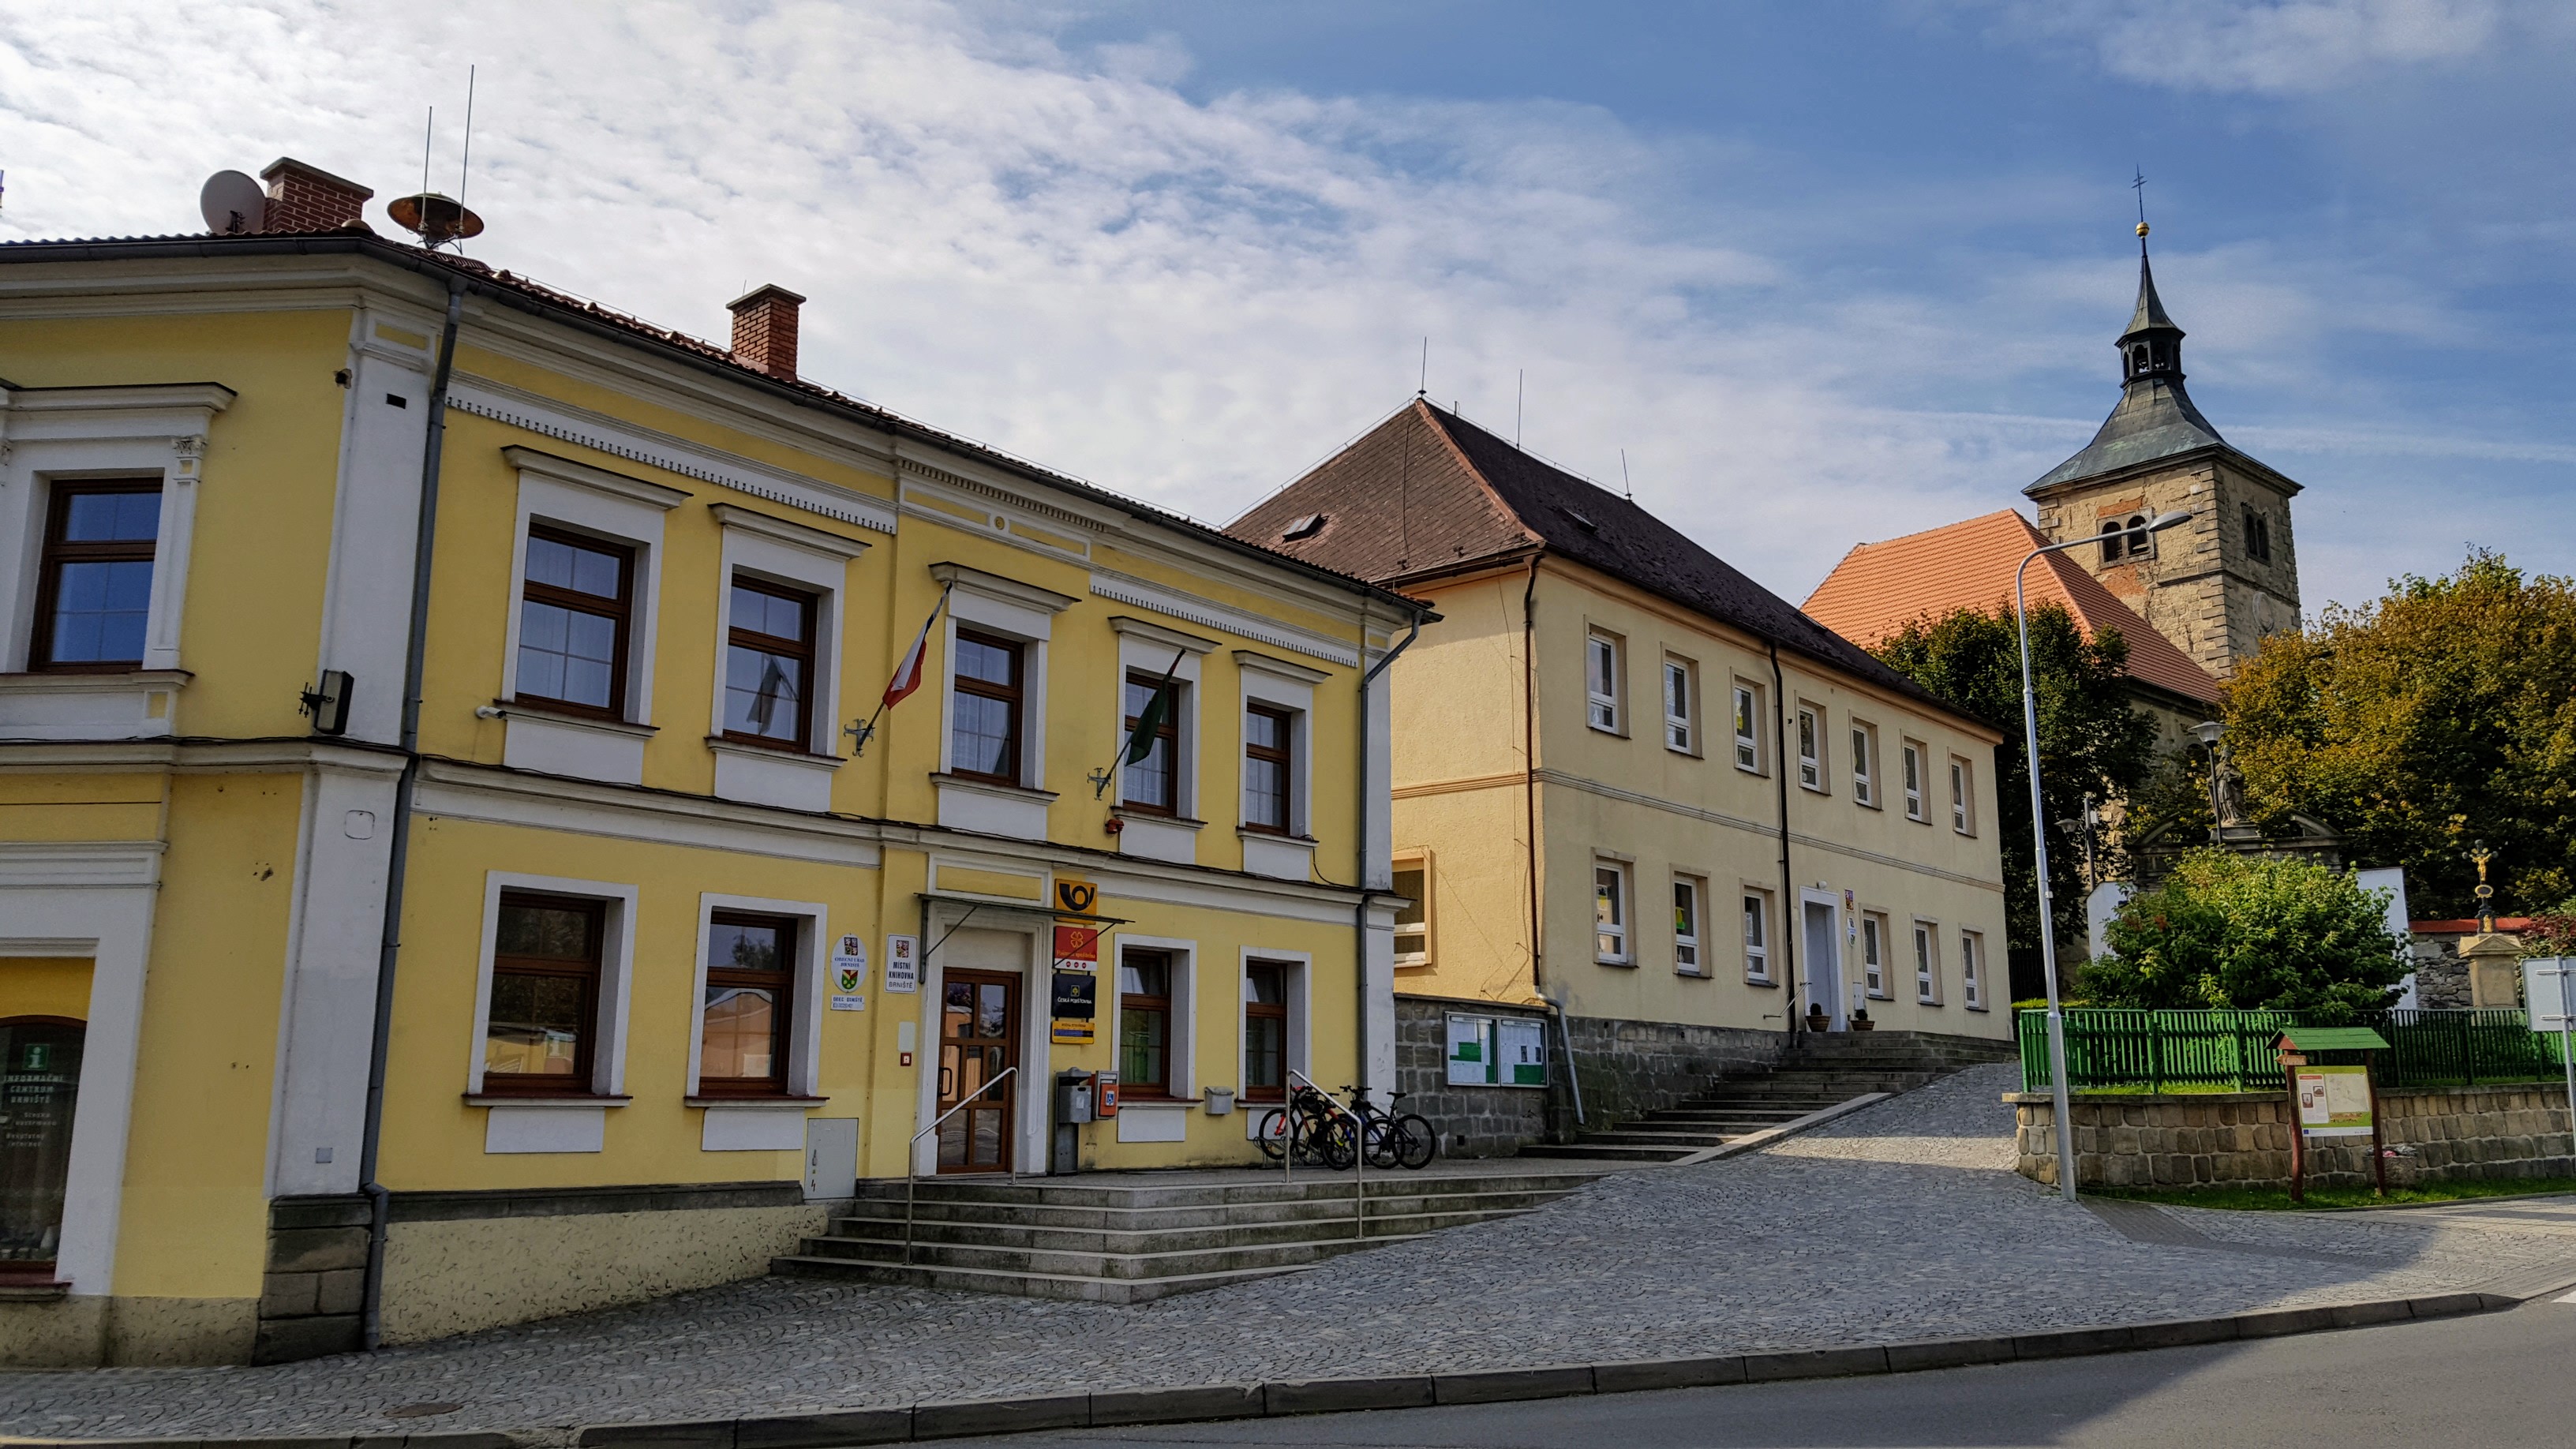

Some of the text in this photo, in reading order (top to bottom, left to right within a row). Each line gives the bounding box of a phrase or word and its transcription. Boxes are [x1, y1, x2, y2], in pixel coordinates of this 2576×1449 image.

[893, 961, 911, 970] MÍSTNÍ
[888, 971, 914, 980] KNIHOVNA
[10, 1095, 51, 1103] BRNIŠTĚ
